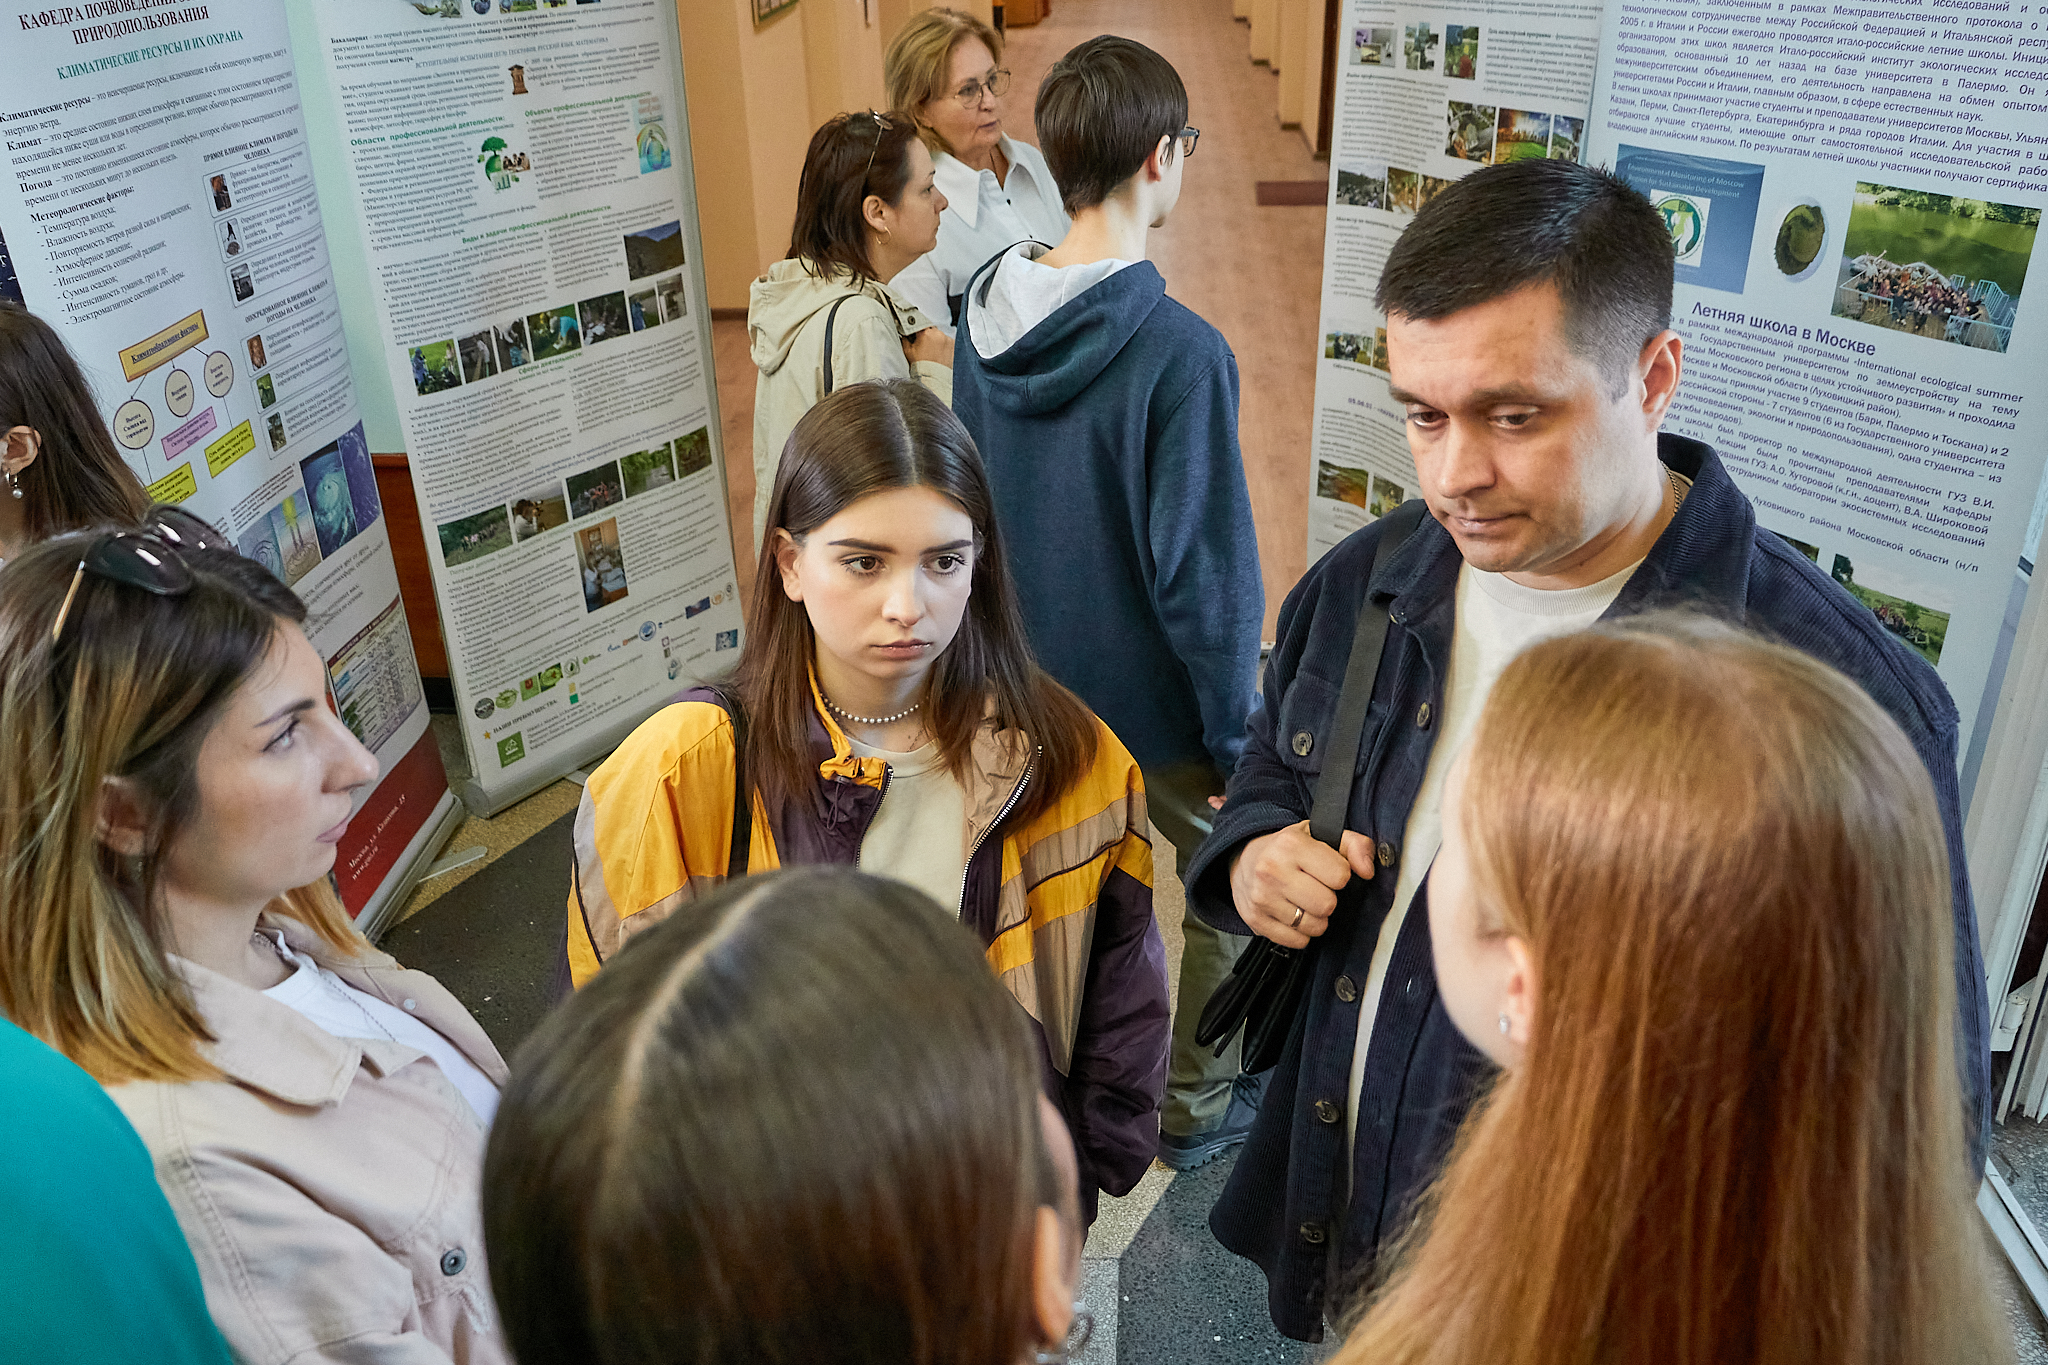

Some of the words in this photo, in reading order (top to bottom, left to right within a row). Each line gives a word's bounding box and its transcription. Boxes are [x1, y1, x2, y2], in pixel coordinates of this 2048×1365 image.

[17, 6, 84, 30] КАФЕДРА
[71, 5, 209, 45] ПРИРОДОПОЛЬЗОВАНИЯ
[1621, 4, 1688, 17] технологическом
[1691, 10, 1761, 24] сотрудничестве
[1765, 16, 1797, 28] между
[1800, 17, 1858, 31] Российской
[1862, 22, 1926, 37] Федерацией
[1930, 30, 1938, 38] и
[1942, 28, 2013, 45] Итальянской
[1777, 2, 1784, 11] в
[1789, 3, 1827, 14] рамках
[1832, 4, 1959, 24] Межправительственного
[1965, 17, 2023, 29] протокола
[2030, 21, 2038, 30] о
[1932, 0, 2010, 12] исследований
[2019, 4, 2028, 13] и
[56, 49, 139, 80] КЛИМАТИЧЕСКИЕ
[140, 40, 183, 60] РЕСУРСЫ
[182, 38, 191, 51] И
[191, 36, 206, 49] ИХ
[205, 30, 243, 46] ОХРАНА
[1617, 30, 1676, 44] организатором
[1680, 37, 1699, 46] этих
[1704, 39, 1727, 49] школ
[1731, 42, 1774, 53] является
[1778, 44, 1866, 62] Итало-российский
[1870, 55, 1914, 69] институт
[1919, 60, 1998, 76] экологических
[1619, 15, 1639, 27] 2005
[1648, 20, 1654, 28] в
[1655, 19, 1686, 31] Италии
[1688, 24, 1694, 32] и
[1696, 23, 1729, 35] России
[1731, 28, 1776, 39] ежегодно
[1778, 32, 1834, 44] проводятся
[1836, 37, 1925, 53] итало-российские
[1927, 45, 1964, 57] летние
[1967, 49, 2007, 60] школы.
[62, 95, 91, 111] ресурсы
[1614, 56, 1698, 74] межуниверситетским
[1703, 66, 1774, 83] объединением,
[1780, 75, 1797, 84] его
[1801, 77, 1865, 92] деятельность
[1871, 85, 1931, 100] направлена
[1938, 93, 1952, 102] на
[1958, 94, 1995, 107] обмен
[2002, 100, 2047, 112] опытом
[2, 123, 39, 137] энергию
[38, 118, 61, 130] ветра.
[349, 136, 386, 146] Области
[389, 122, 457, 141] профессиональной
[457, 115, 504, 129] деятельности:
[19, 179, 53, 193] Погода
[29, 195, 106, 223] Метеорологические
[105, 185, 135, 203] факторы:
[40, 215, 90, 234] Температура
[89, 206, 116, 221] воздуха;
[44, 230, 88, 248] Влажность
[87, 220, 115, 235] воздуха;
[1691, 301, 1745, 324] Летняя
[1749, 315, 1797, 337] школа
[1801, 328, 1811, 340] в
[1815, 328, 1876, 356] Москве
[1678, 317, 1685, 325] в
[1687, 319, 1720, 332] рамках
[1723, 326, 1794, 349] международной
[1796, 344, 1850, 363] программы
[1920, 375, 1972, 393] ecological
[1975, 387, 2024, 402] summer
[1719, 361, 1772, 383] Московской
[1773, 377, 1808, 392] области
[1809, 385, 1865, 408] (Луховицкий
[1866, 402, 1901, 419] район).
[1728, 390, 1765, 406] стороны
[1771, 400, 1778, 409] 7
[1778, 404, 1821, 422] студентов
[1822, 415, 1832, 426] (6
[1833, 420, 1845, 429] из
[1845, 422, 1930, 453] Государственного
[1930, 447, 2005, 470] университета
[1684, 416, 1713, 429] школы
[1716, 423, 1734, 435] был
[1737, 430, 1783, 450] проректор
[1786, 444, 1798, 454] по
[1801, 449, 1872, 477] международной
[1875, 472, 1942, 497] деятельности
[1947, 490, 1967, 503] ГУЗ
[1972, 496, 1994, 509] В.И.
[1752, 495, 1805, 519] Луховицкого
[1808, 515, 1842, 532] района
[1846, 526, 1904, 552] Московской
[1908, 548, 1949, 565] области
[1954, 559, 1979, 572] (н/п
[1781, 481, 1837, 504] лаборатории
[1840, 500, 1908, 527] экосистемных
[1911, 522, 1985, 547] исследований
